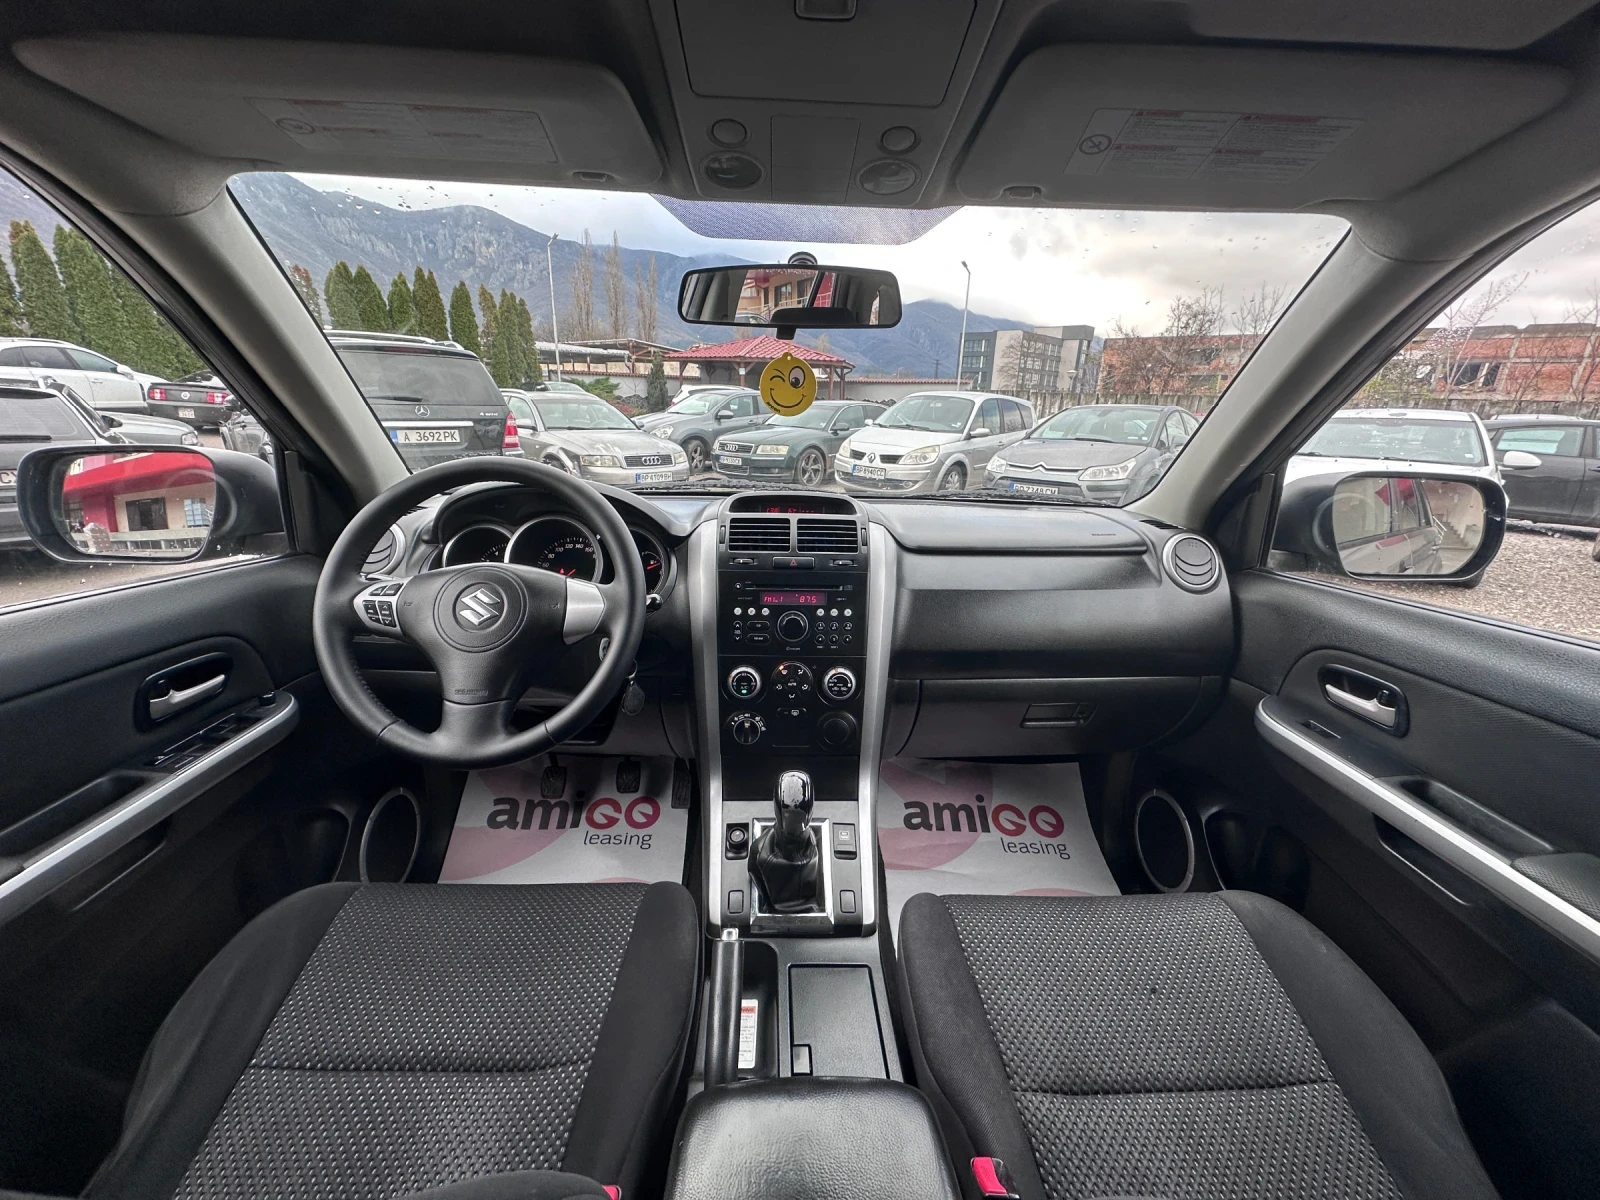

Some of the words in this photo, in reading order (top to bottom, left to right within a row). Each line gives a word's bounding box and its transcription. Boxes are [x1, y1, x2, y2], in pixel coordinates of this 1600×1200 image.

[404, 432, 411, 442] A
[486, 790, 661, 830] amiGO
[903, 794, 1065, 838] amiGO
[583, 830, 653, 850] leasing
[1000, 837, 1071, 860] leasing
